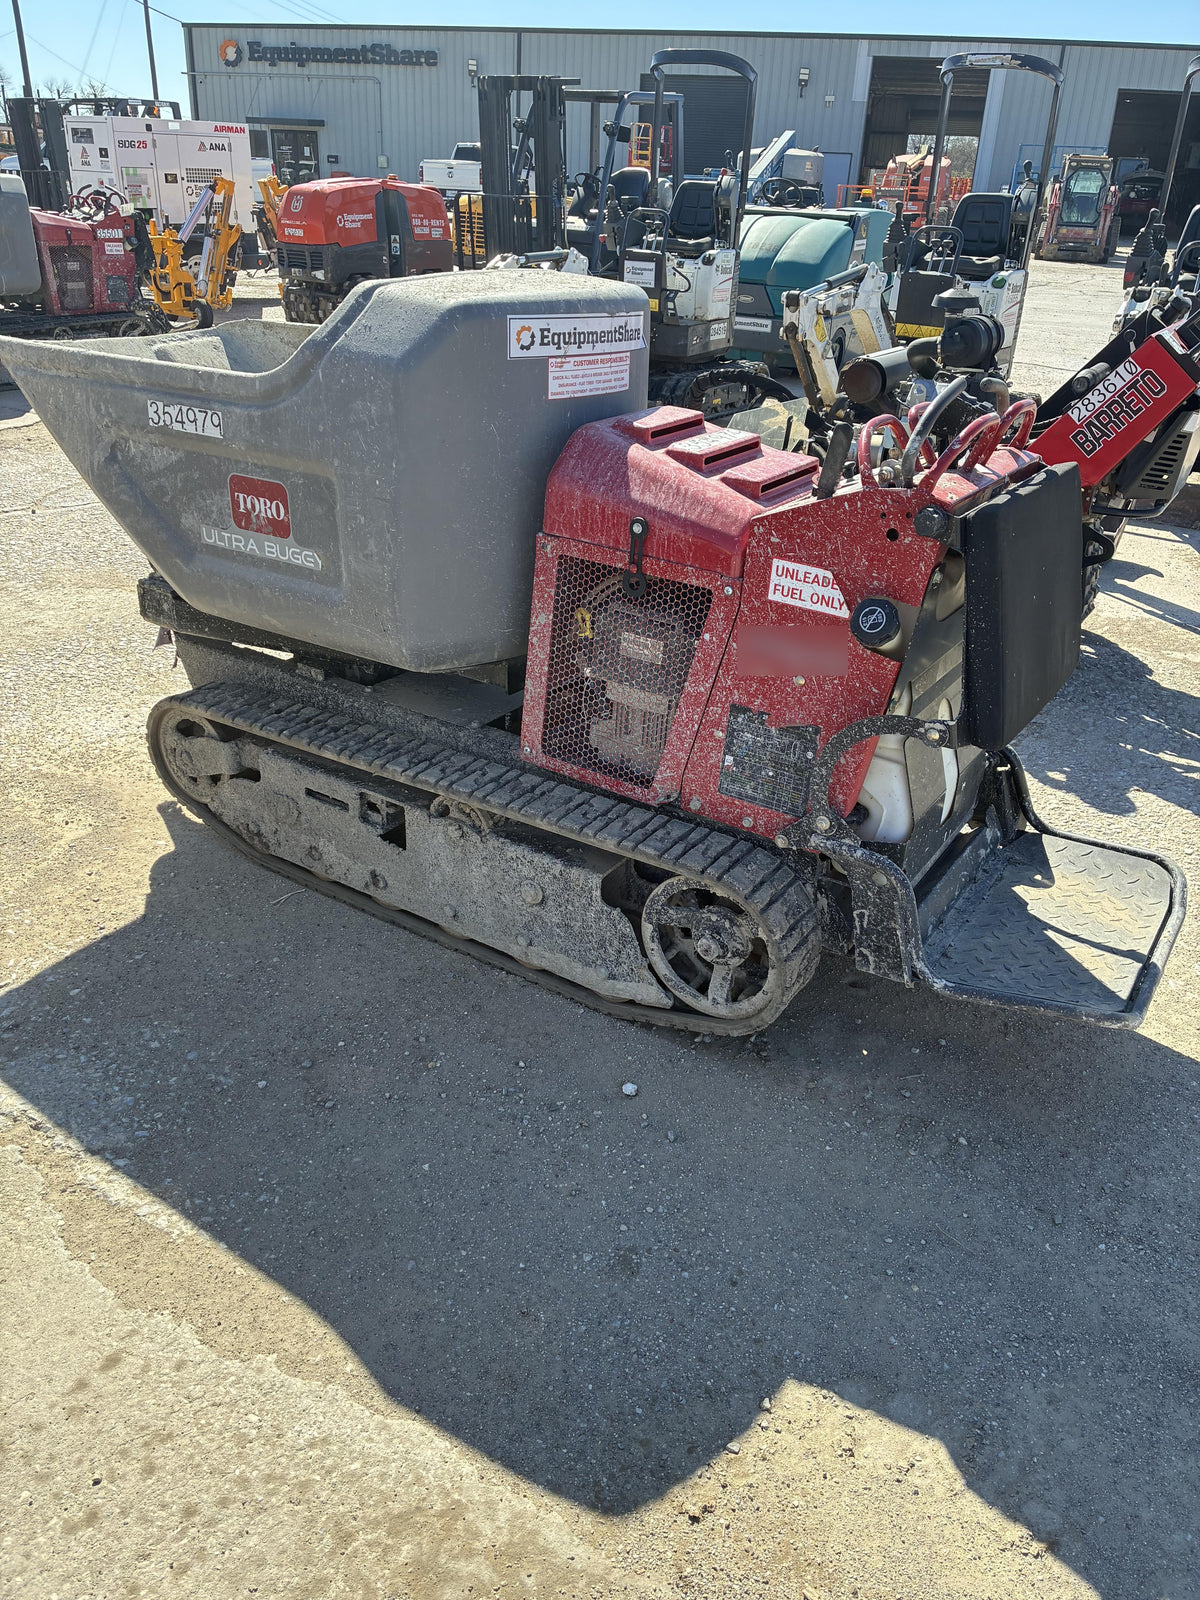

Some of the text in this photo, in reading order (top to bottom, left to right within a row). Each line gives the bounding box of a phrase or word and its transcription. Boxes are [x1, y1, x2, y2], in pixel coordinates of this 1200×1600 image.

[247, 41, 438, 67] EquipmentShare
[213, 125, 246, 134] AIRMAN
[209, 142, 227, 152] ANA
[81, 159, 91, 167] ANA
[343, 213, 373, 221] Equipment
[539, 324, 641, 350] EquipmentShare
[573, 358, 600, 367] CUSTOMER
[1071, 360, 1138, 423] 283610
[150, 401, 223, 434] 354979
[1069, 368, 1168, 459] BARRETO
[234, 492, 285, 521] TORO
[203, 527, 259, 554] ULTRA
[775, 565, 839, 591] UNLEADE
[773, 584, 845, 611] FUEL ONLY
